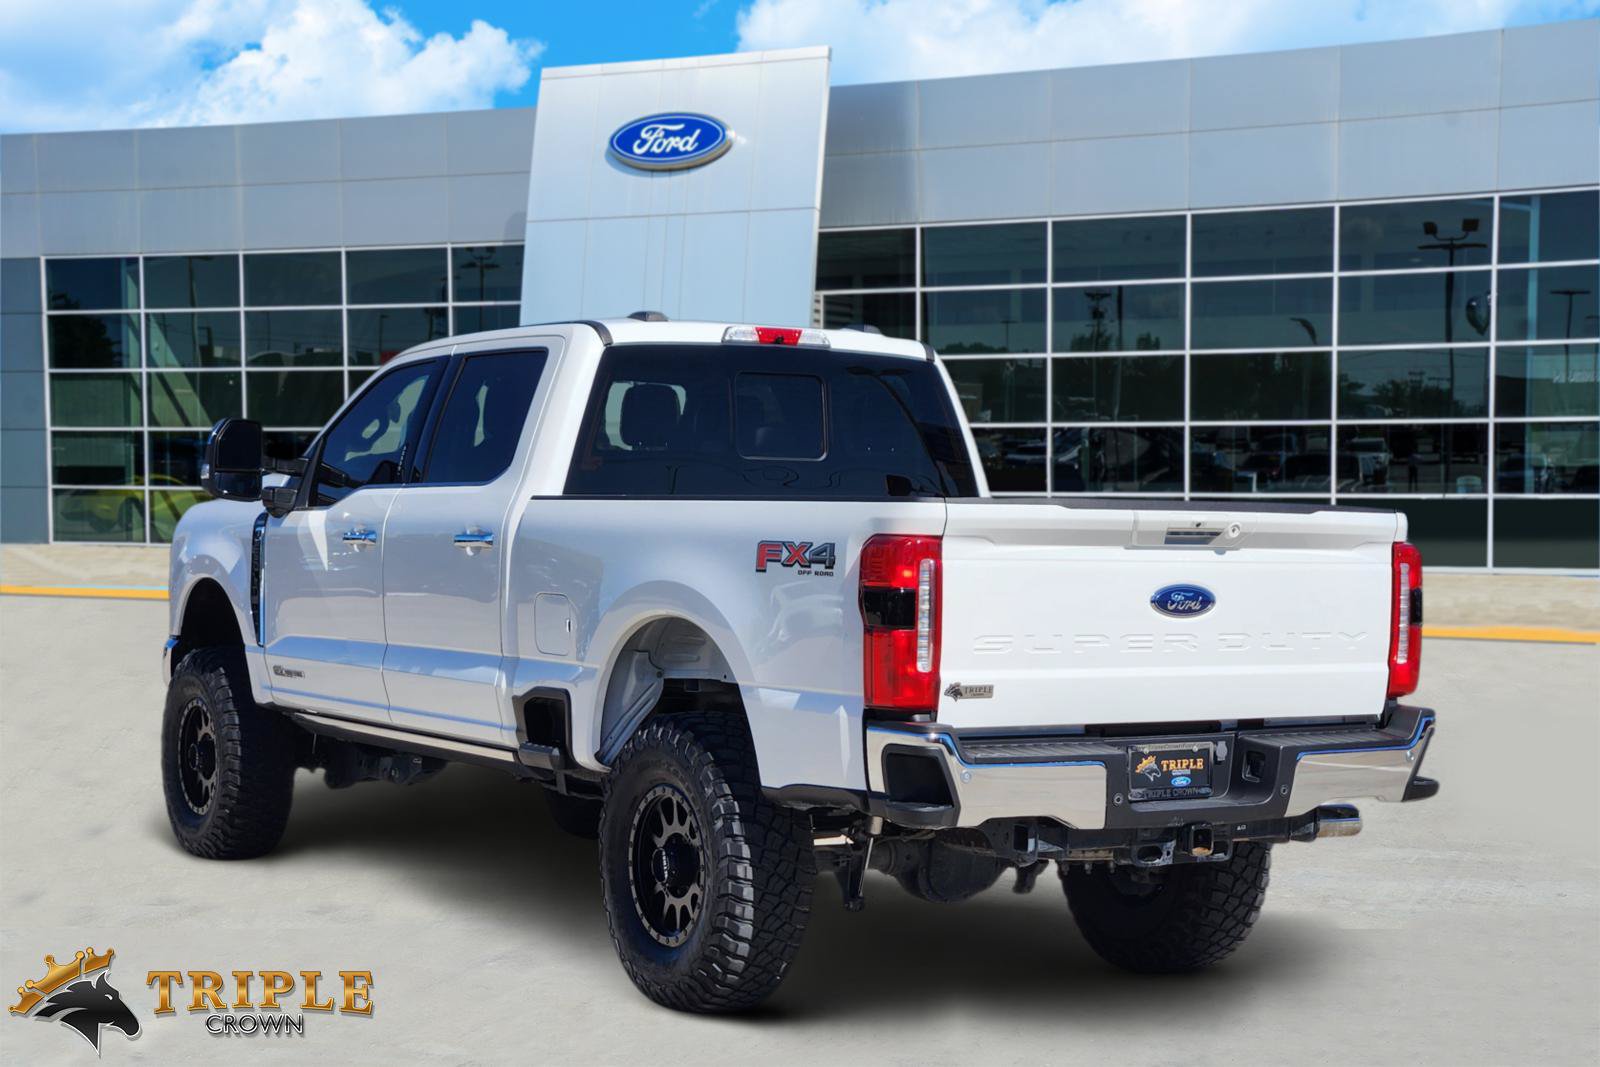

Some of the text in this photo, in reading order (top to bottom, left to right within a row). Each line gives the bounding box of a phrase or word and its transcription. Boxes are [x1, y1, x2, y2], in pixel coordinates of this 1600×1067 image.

[632, 123, 701, 155] Ford
[756, 540, 836, 573] FX4
[1167, 591, 1203, 610] Ford
[973, 631, 1369, 655] SUPER DUTY
[1161, 758, 1204, 771] TRIPLE
